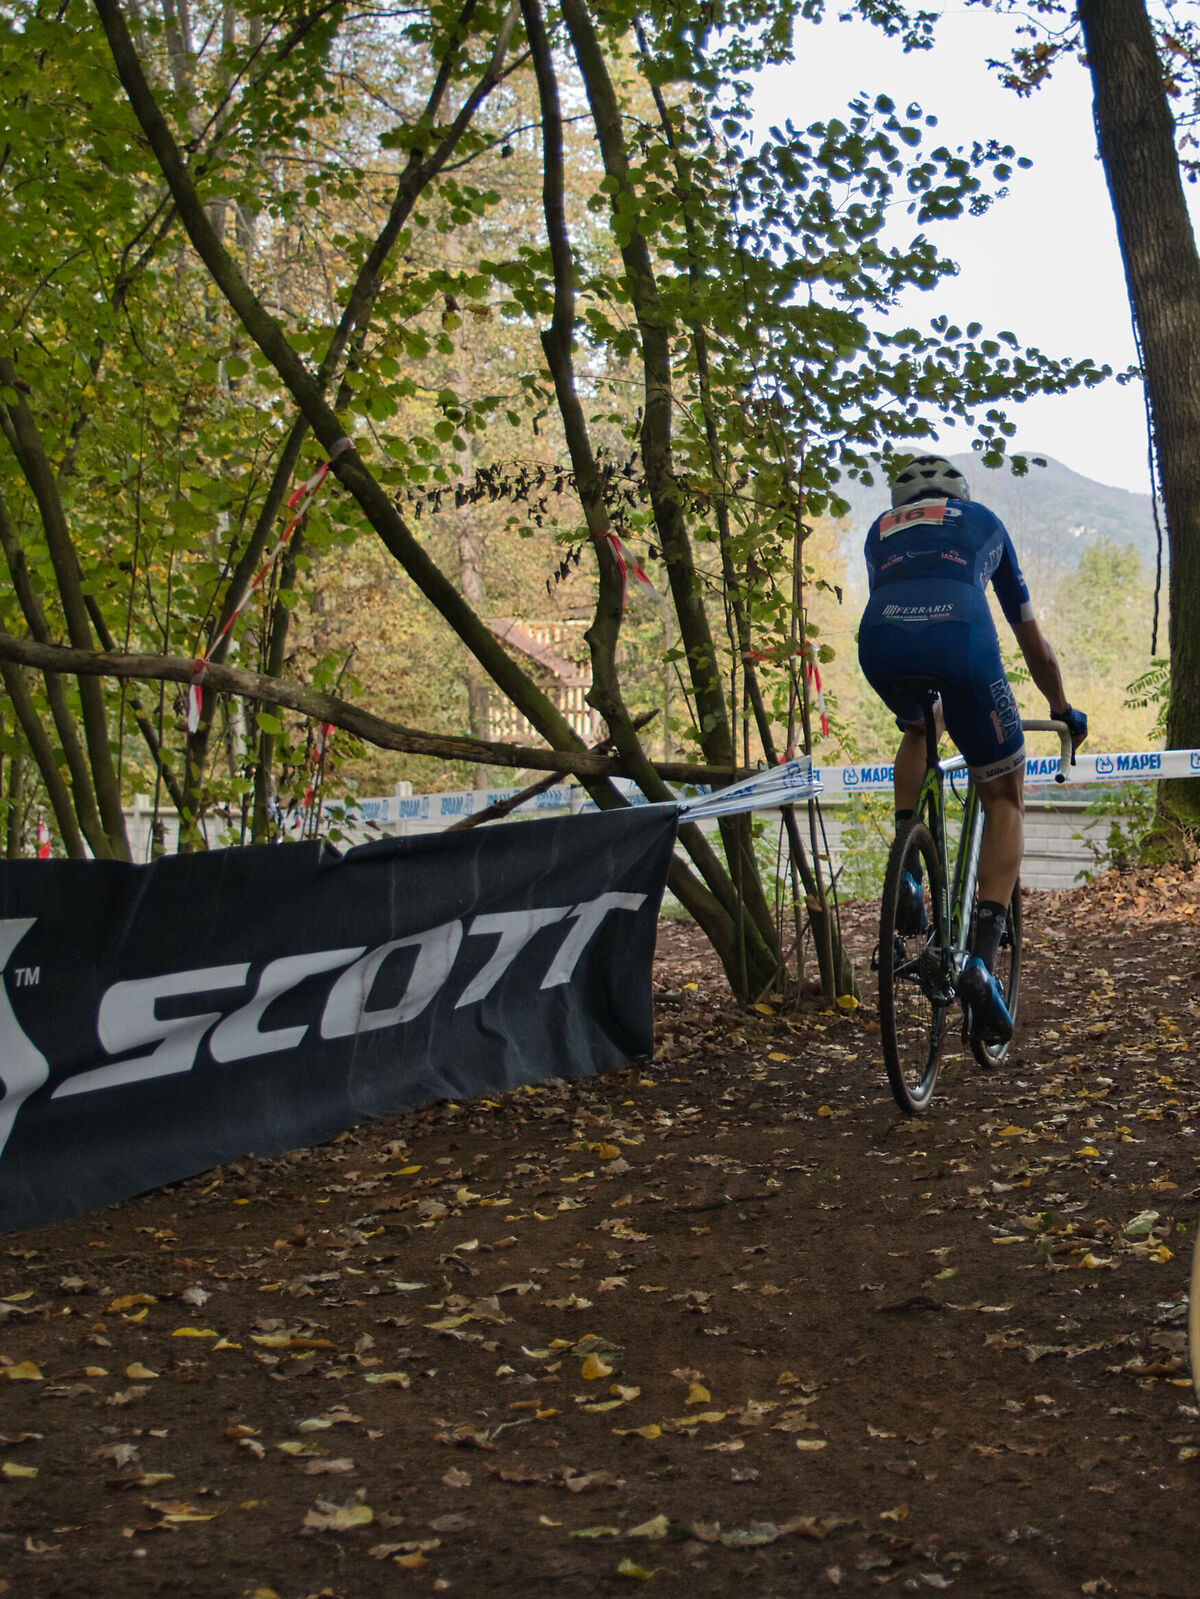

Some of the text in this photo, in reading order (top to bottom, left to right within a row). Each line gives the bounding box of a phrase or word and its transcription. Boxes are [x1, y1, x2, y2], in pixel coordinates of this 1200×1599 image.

[1026, 758, 1062, 776] MAP
[1116, 753, 1161, 771] MAPEI
[861, 767, 895, 783] MAPE
[50, 891, 648, 1100] SCOTT
